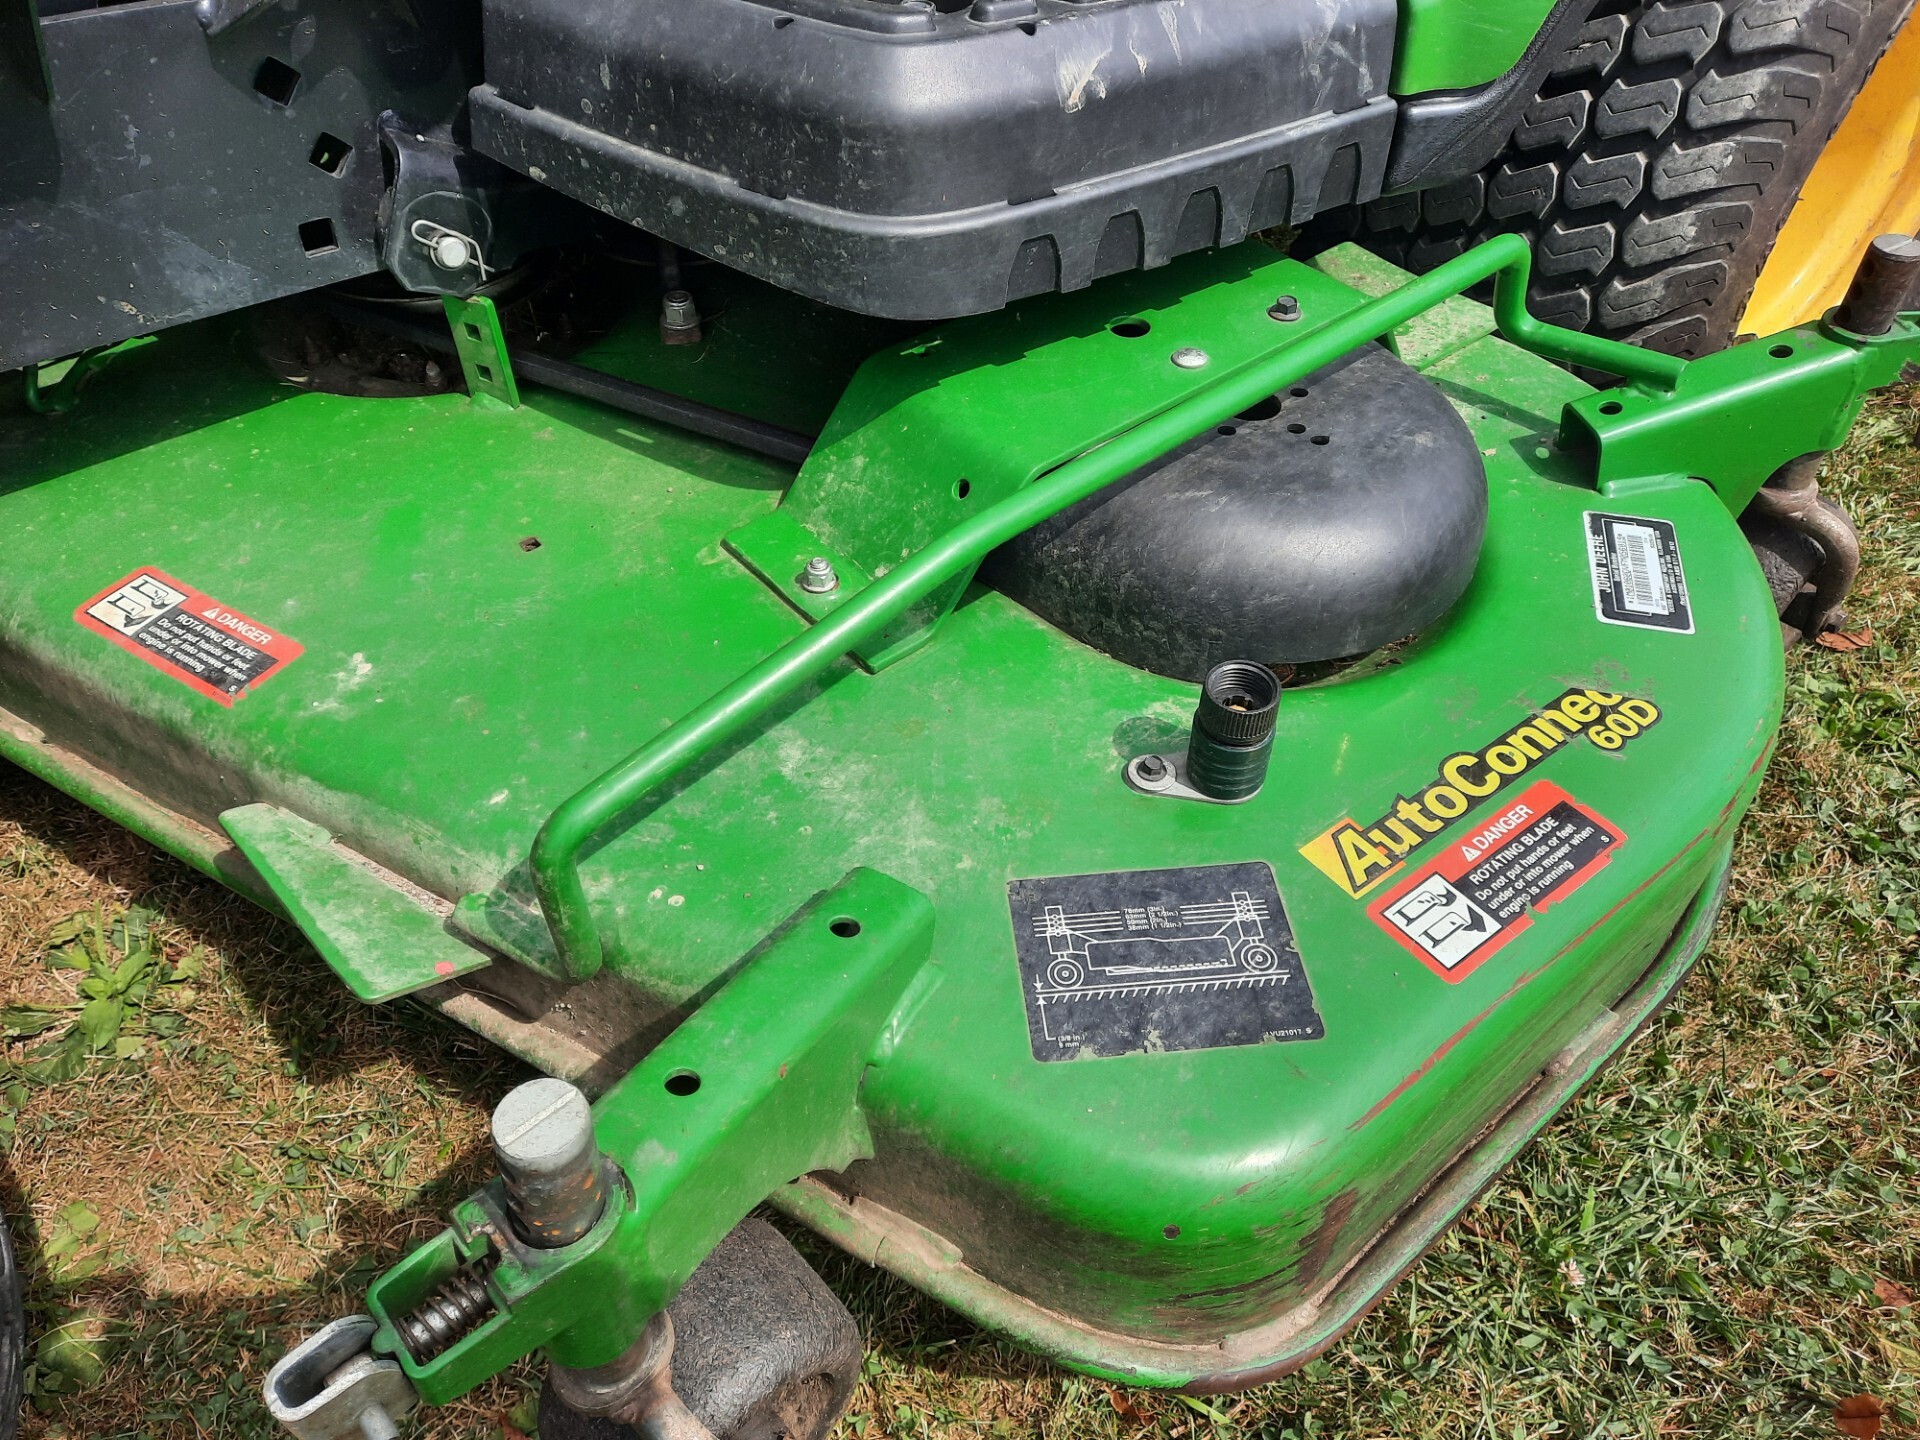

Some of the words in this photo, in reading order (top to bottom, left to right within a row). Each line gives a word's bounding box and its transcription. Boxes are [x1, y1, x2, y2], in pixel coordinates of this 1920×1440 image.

[1593, 534, 1607, 564] DEERE
[1596, 567, 1611, 593] JOHN
[1612, 569, 1621, 582] Serial
[157, 618, 171, 628] Do
[169, 626, 186, 635] not
[181, 633, 200, 643] put
[197, 639, 223, 656] hands
[231, 658, 250, 670] feet
[175, 614, 225, 642] ROTATING
[222, 639, 258, 659] BLADE
[216, 613, 272, 644] DANGER
[139, 632, 167, 649] engine
[164, 646, 175, 654] is
[173, 651, 206, 672] running
[148, 626, 173, 640] under
[180, 642, 198, 654] into
[196, 652, 224, 668] mower
[223, 666, 247, 681] when
[1339, 690, 1623, 887] AutoConnec
[1588, 699, 1659, 750] 60D
[1472, 805, 1533, 849] DANGER
[1469, 843, 1525, 885] ROTATING
[1520, 817, 1559, 846] BLADE
[1475, 889, 1492, 900] Do
[1491, 875, 1509, 890] not
[1506, 864, 1524, 880] put
[1519, 845, 1550, 867] hands
[1548, 837, 1560, 846] or
[1556, 823, 1577, 839] feet
[1488, 887, 1515, 909] under
[1514, 879, 1526, 889] or
[1522, 866, 1544, 881] into
[1541, 843, 1571, 868] mower
[1569, 827, 1594, 846] when
[1526, 886, 1540, 895] is
[1538, 860, 1574, 888] running
